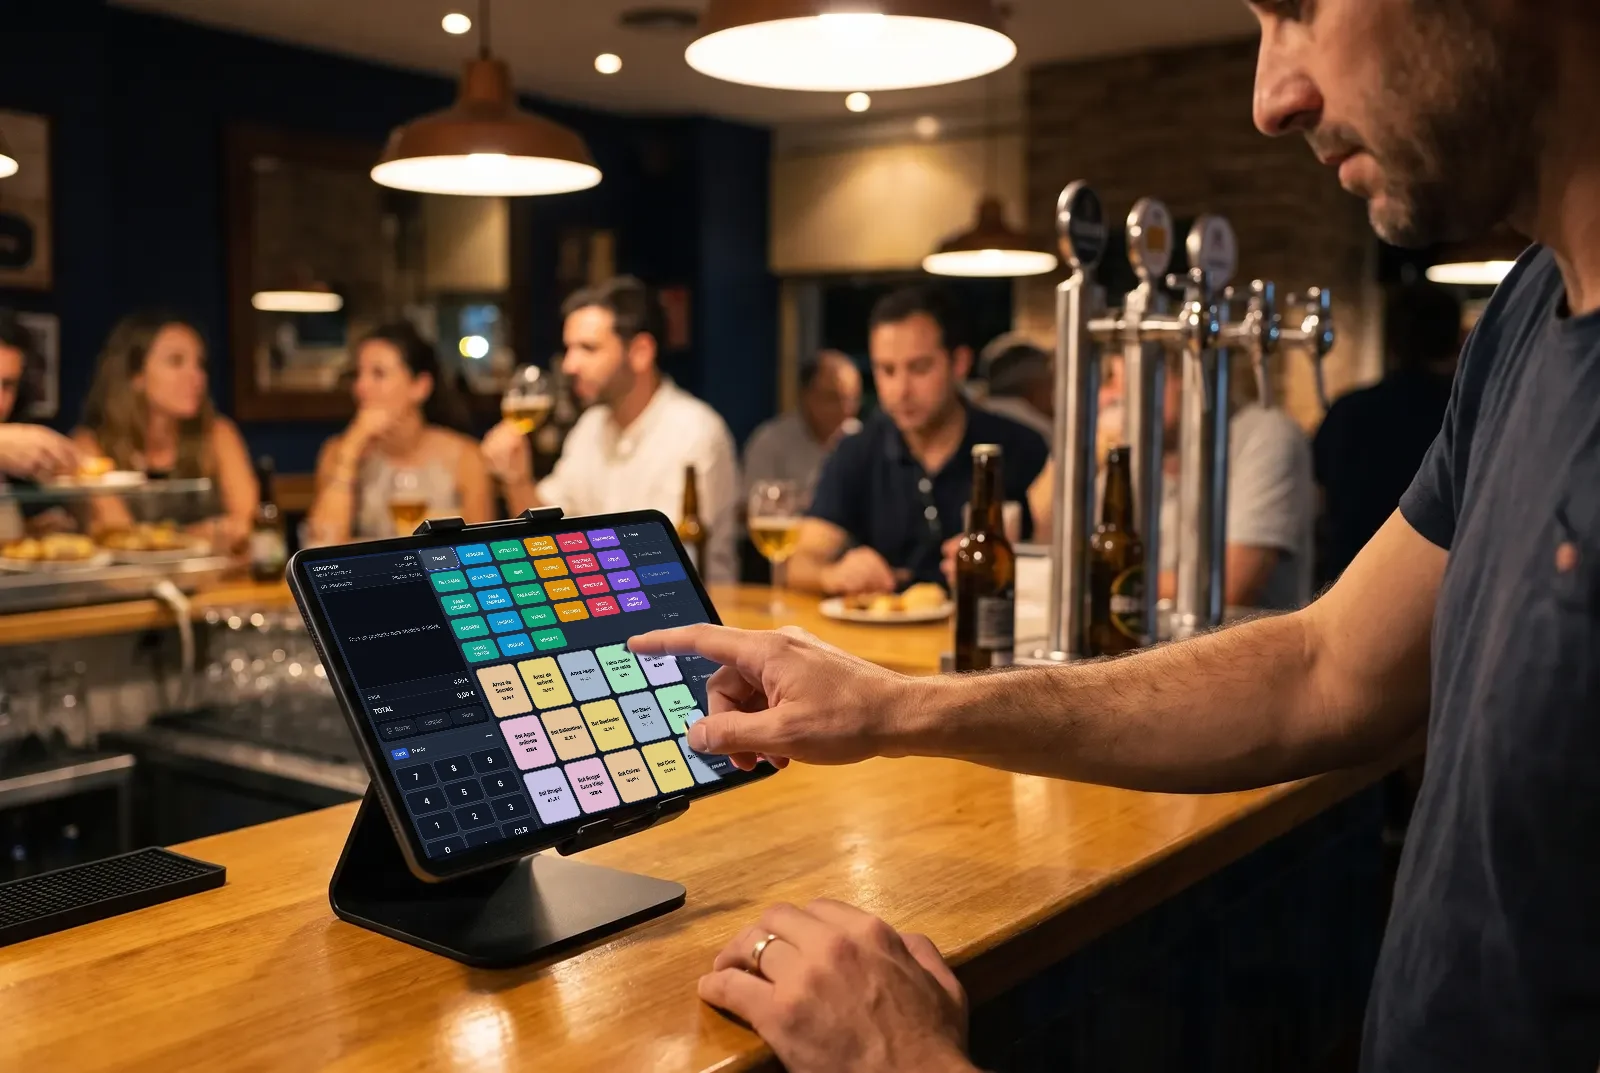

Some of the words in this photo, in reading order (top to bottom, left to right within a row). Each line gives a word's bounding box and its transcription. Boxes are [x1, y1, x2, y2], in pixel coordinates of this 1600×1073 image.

[373, 705, 394, 715] TOTAL
[456, 691, 470, 700] 0,00
[487, 756, 493, 764] 9
[451, 764, 457, 772] 8
[413, 773, 419, 781] 7
[461, 788, 468, 796] 5
[424, 797, 431, 805] 4
[507, 803, 514, 811] 3
[472, 812, 479, 820] 2
[514, 826, 529, 836] CLR
[445, 846, 451, 854] 0
